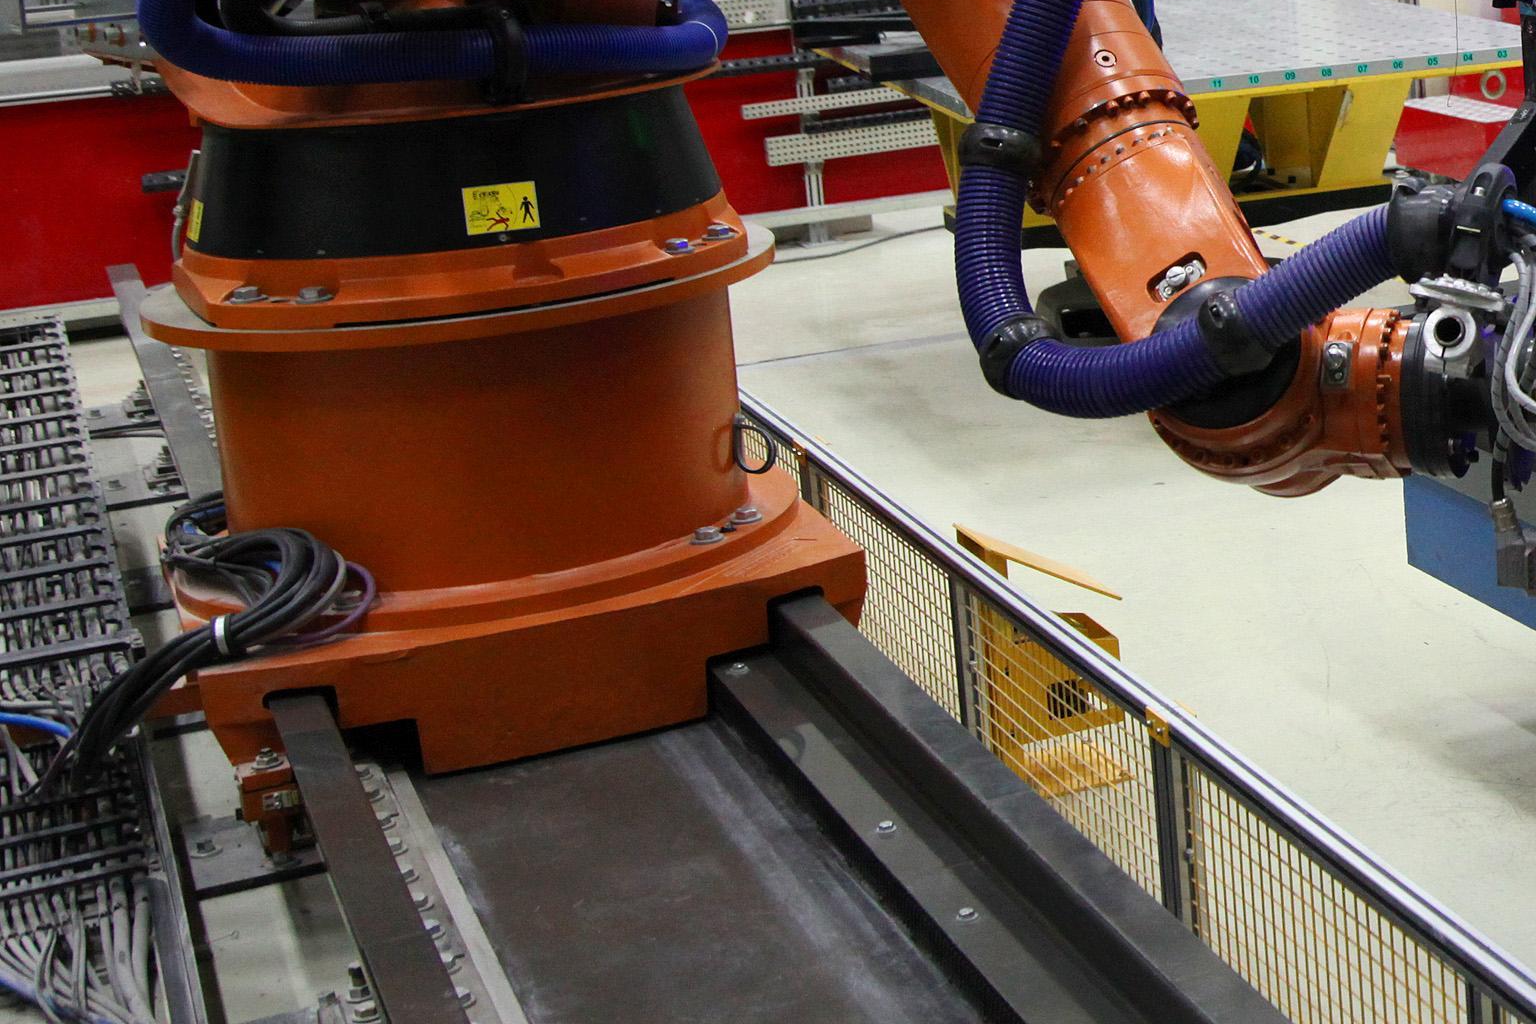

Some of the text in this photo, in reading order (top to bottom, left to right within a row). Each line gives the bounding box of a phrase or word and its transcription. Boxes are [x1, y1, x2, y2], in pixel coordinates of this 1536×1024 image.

[1213, 49, 1508, 88] 11 10 09 08 07 06 05 04 03
